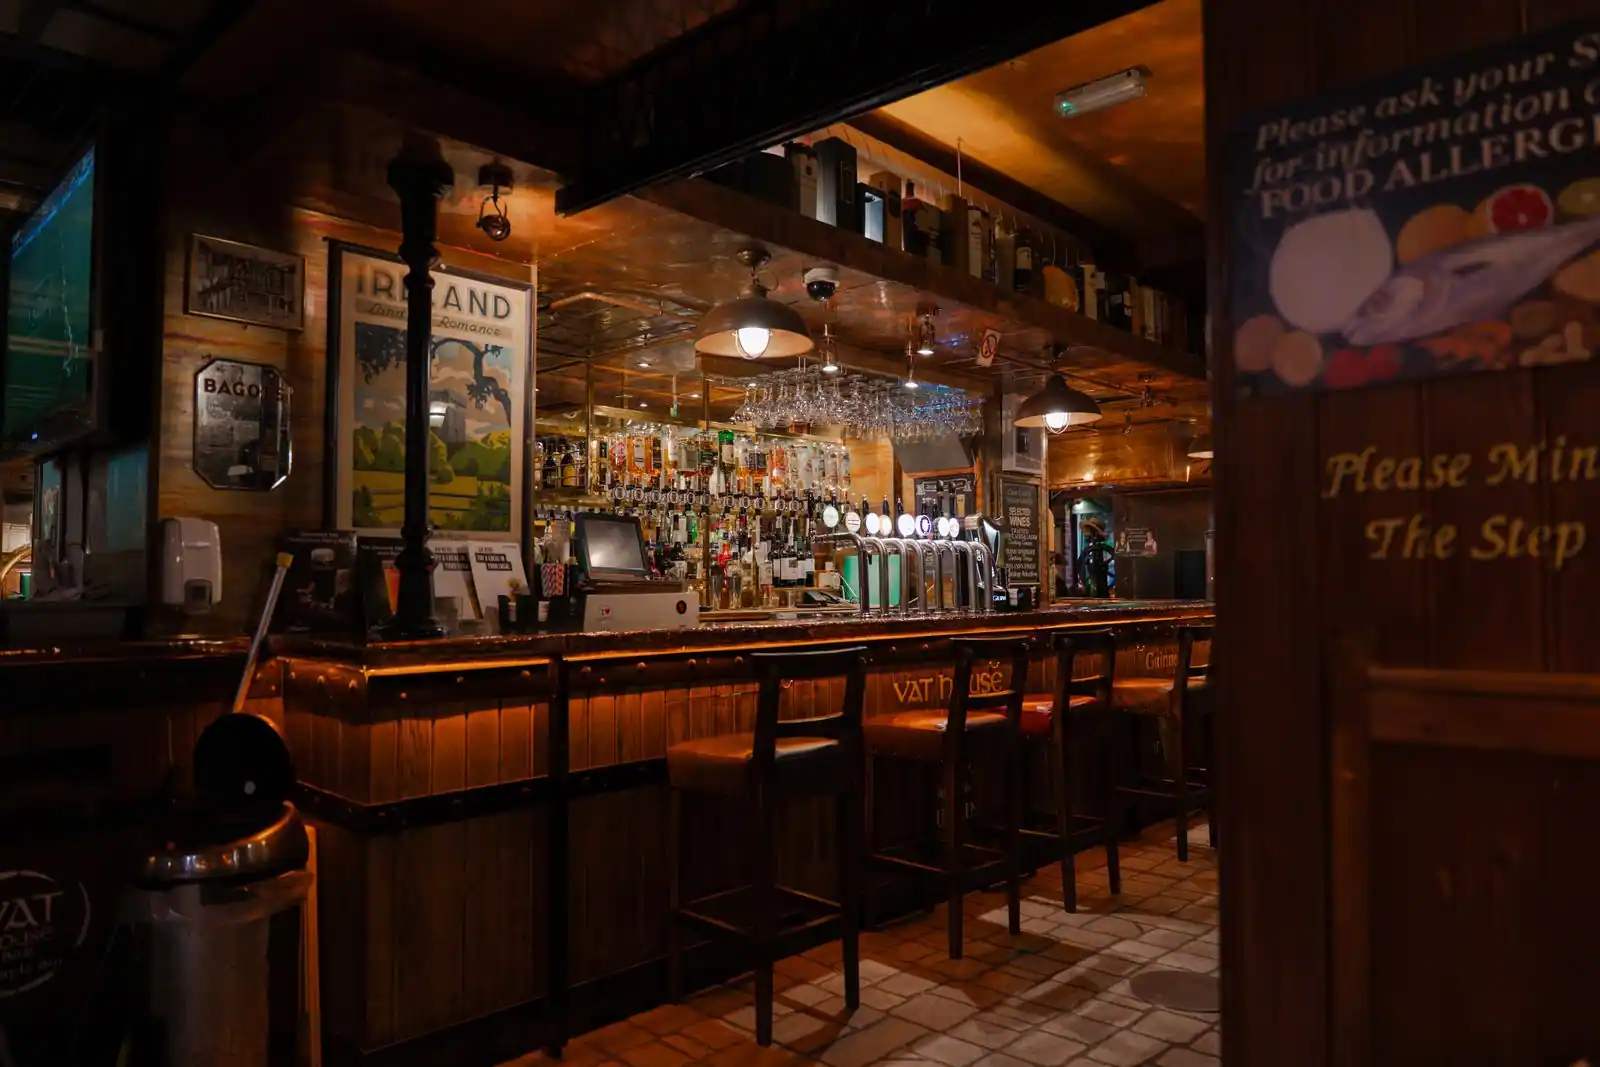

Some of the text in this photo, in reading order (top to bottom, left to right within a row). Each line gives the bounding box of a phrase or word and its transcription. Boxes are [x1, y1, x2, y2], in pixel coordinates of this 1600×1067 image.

[1256, 105, 1366, 151] Please
[1375, 76, 1444, 120] ask
[1453, 51, 1556, 107] your
[1247, 155, 1303, 192] for
[1315, 86, 1571, 169] information
[1258, 170, 1375, 219] FOOD
[356, 263, 511, 319] IRAND
[438, 316, 501, 336] Romance
[1320, 444, 1473, 500] Please
[1009, 516, 1031, 528] WINES
[1364, 513, 1587, 571] The Step
[893, 671, 1004, 704] VAT huse
